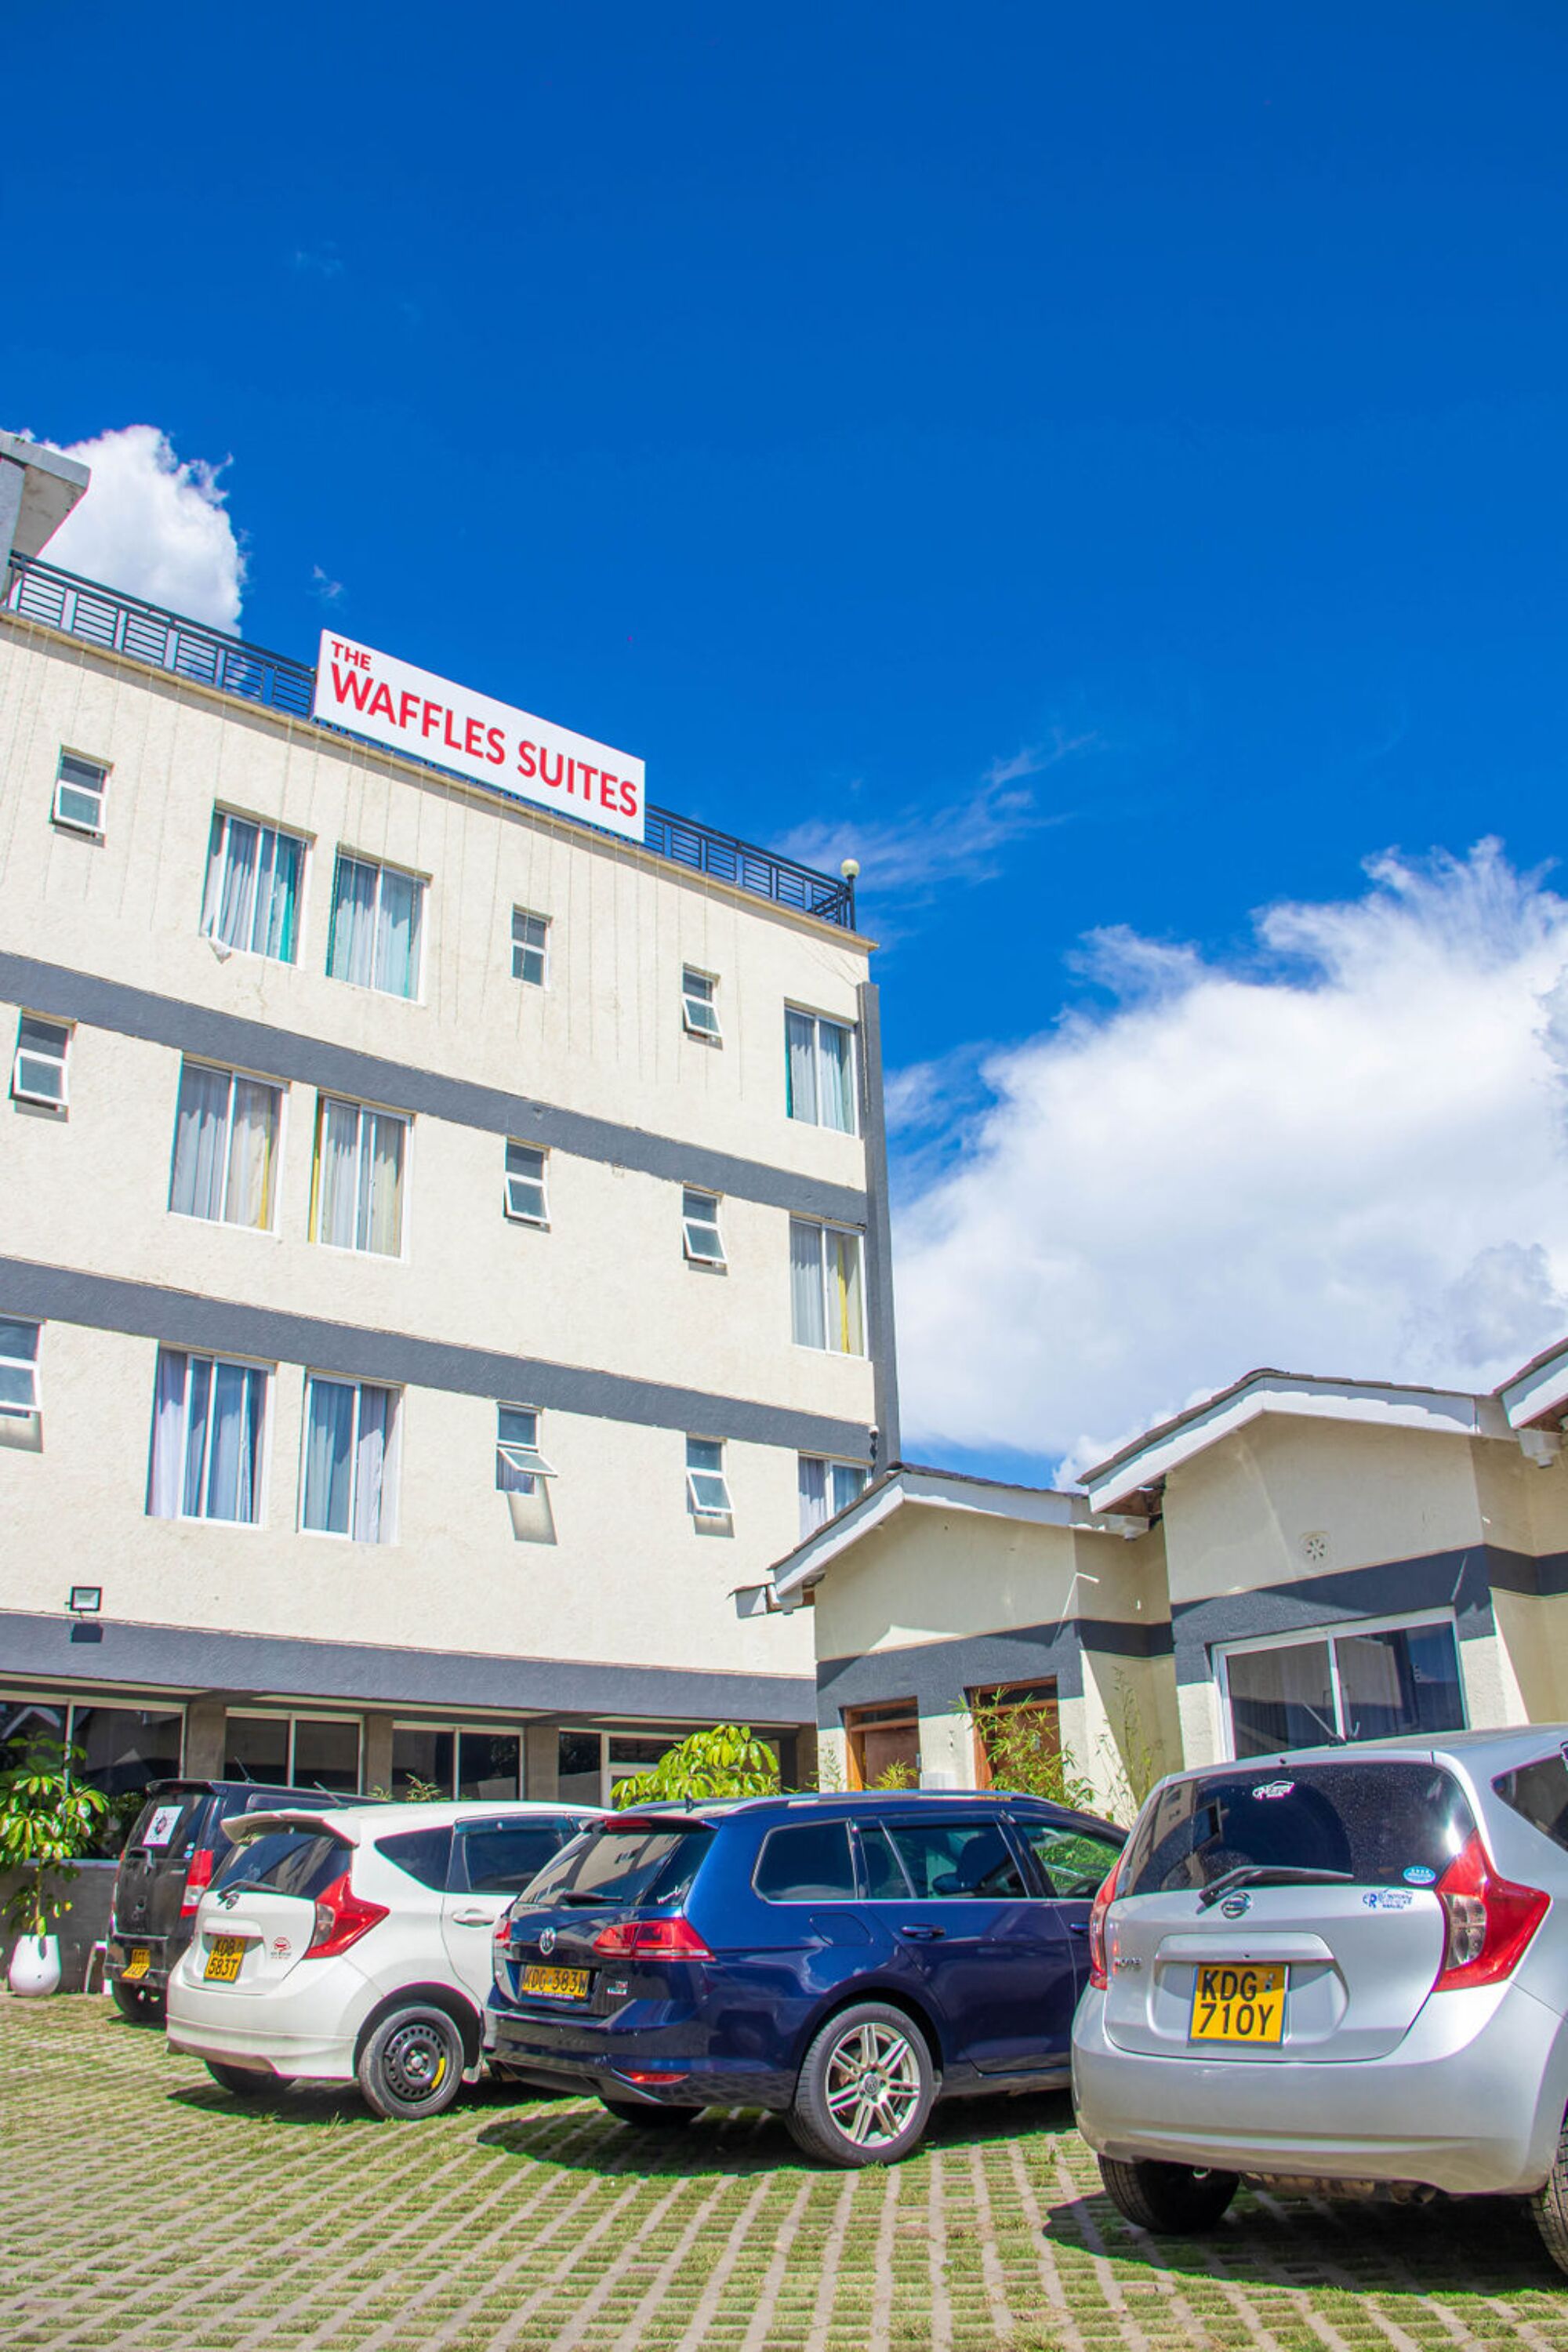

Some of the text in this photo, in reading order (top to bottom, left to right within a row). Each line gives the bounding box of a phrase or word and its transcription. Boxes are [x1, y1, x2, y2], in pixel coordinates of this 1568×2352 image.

[332, 641, 372, 671] THE
[332, 662, 637, 817] WAFFLES SUITES
[1202, 1969, 1258, 2002] KDG
[1199, 2002, 1275, 2036] 710Y
